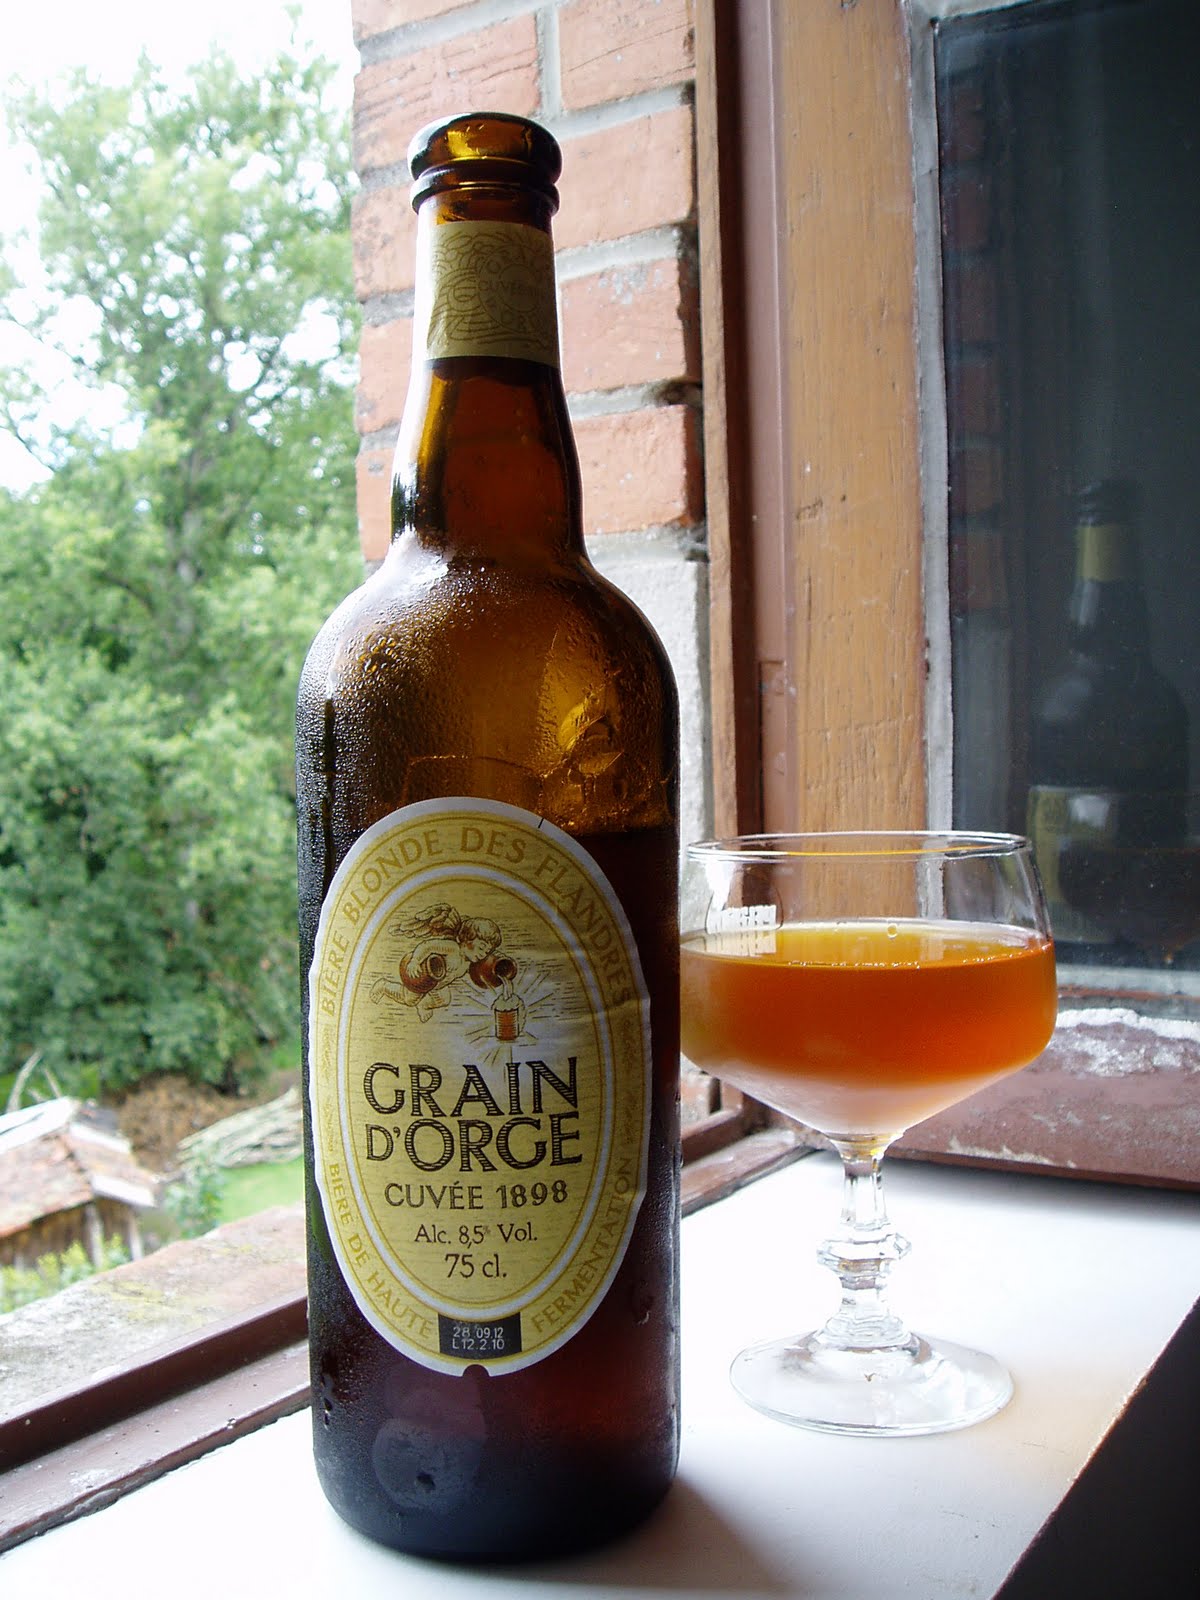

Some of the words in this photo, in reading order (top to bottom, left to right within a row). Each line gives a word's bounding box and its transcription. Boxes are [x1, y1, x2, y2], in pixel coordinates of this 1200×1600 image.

[343, 829, 443, 925] BLONDE
[460, 827, 527, 863] DES
[534, 854, 631, 1007] FLANDRES
[364, 1057, 578, 1117] GRAIN
[366, 1111, 583, 1172] D'ORGE
[384, 1181, 484, 1210] CUVÉE
[496, 1180, 569, 1209] 1898
[349, 1234, 371, 1268] DE
[367, 1271, 434, 1339] HAUTE
[531, 1157, 634, 1333] FERMENTATION
[414, 1223, 452, 1245] Alc.
[497, 1222, 538, 1243] Vol.
[445, 1253, 475, 1279] 75
[482, 1253, 507, 1279] cl.
